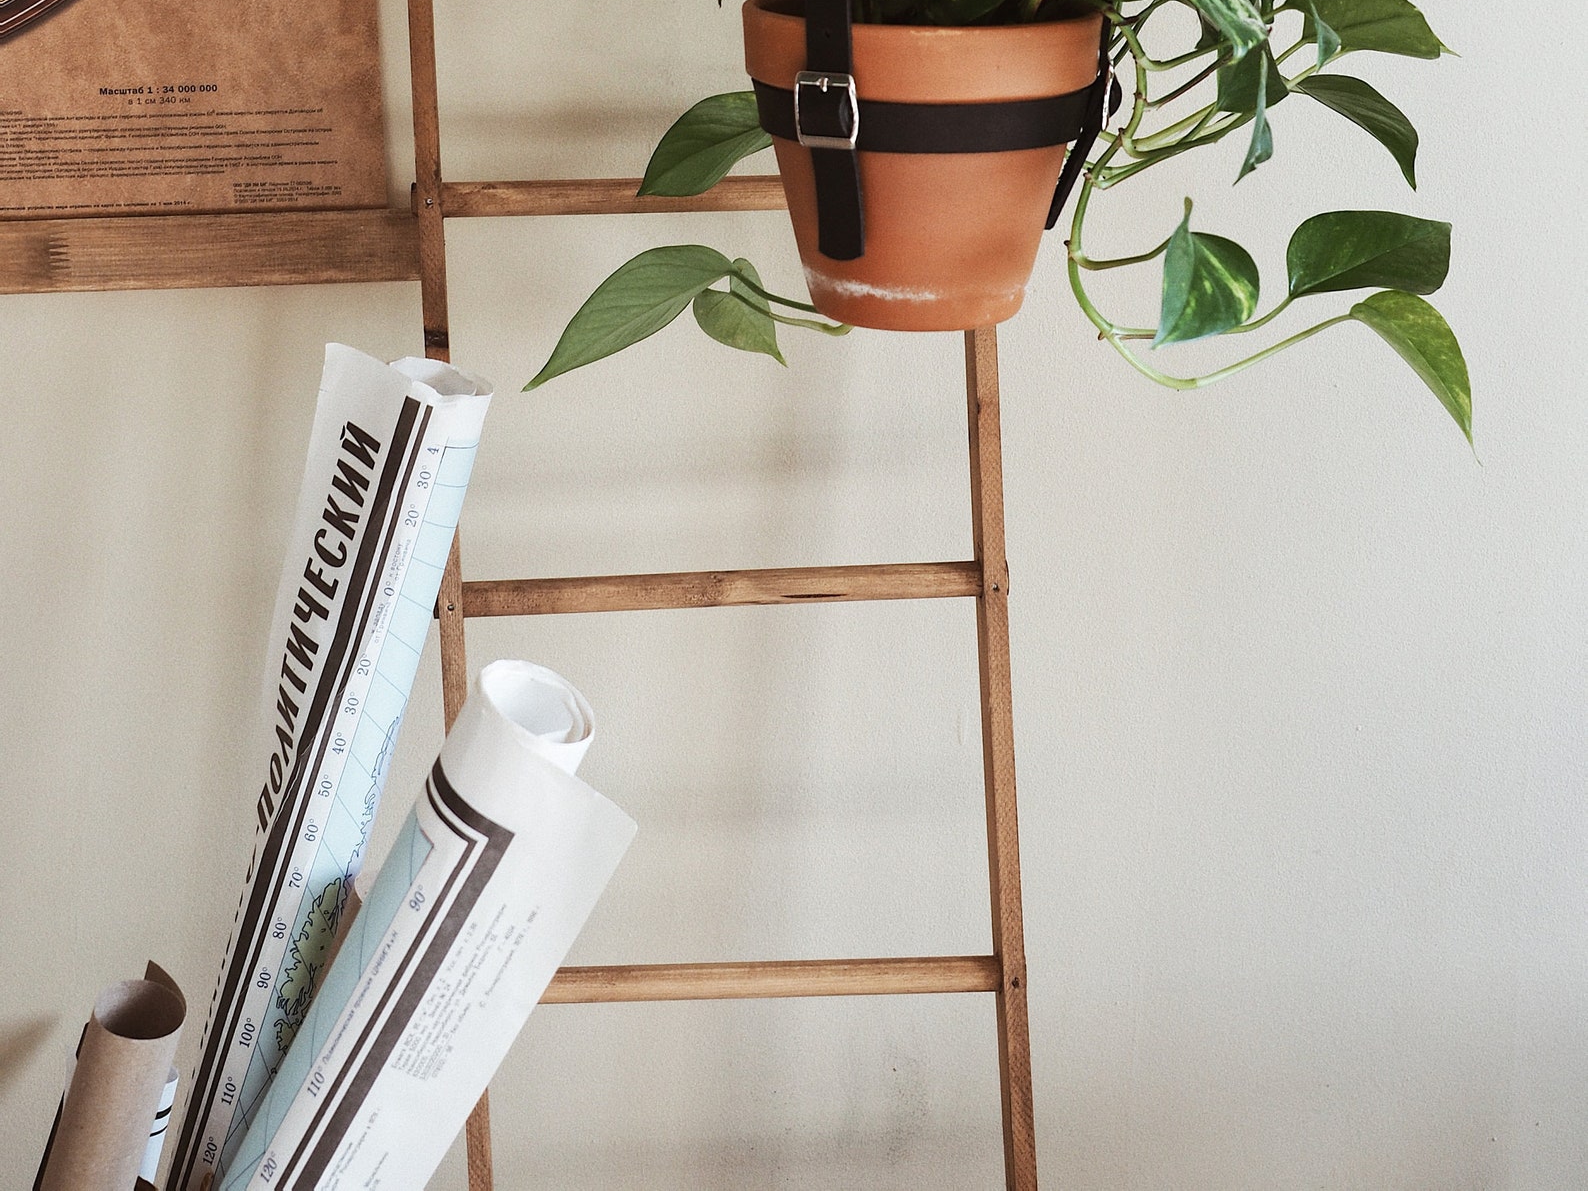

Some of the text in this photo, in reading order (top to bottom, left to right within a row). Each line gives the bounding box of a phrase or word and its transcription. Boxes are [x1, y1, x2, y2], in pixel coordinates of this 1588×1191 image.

[99, 87, 144, 96] Масштаб
[178, 85, 196, 93] 000
[199, 84, 218, 92] 000
[159, 96, 177, 104] 340
[416, 464, 432, 490] 30°
[404, 503, 420, 528] 20°
[256, 420, 382, 834] ПОЛИТИЧЕСКИЙ
[357, 653, 372, 677] 20°
[344, 691, 360, 716] 30°
[332, 731, 347, 756] 40°
[318, 774, 333, 798] 50°
[304, 818, 319, 843] 60°
[289, 866, 303, 890] 70°
[409, 884, 426, 912] 90°
[273, 916, 287, 940] 80°
[257, 967, 271, 990] 90°
[239, 1017, 256, 1049] 100°
[221, 1076, 237, 1106] 110°
[306, 1065, 325, 1098] 110°
[202, 1136, 219, 1166] 120°
[260, 1150, 279, 1184] 120°
